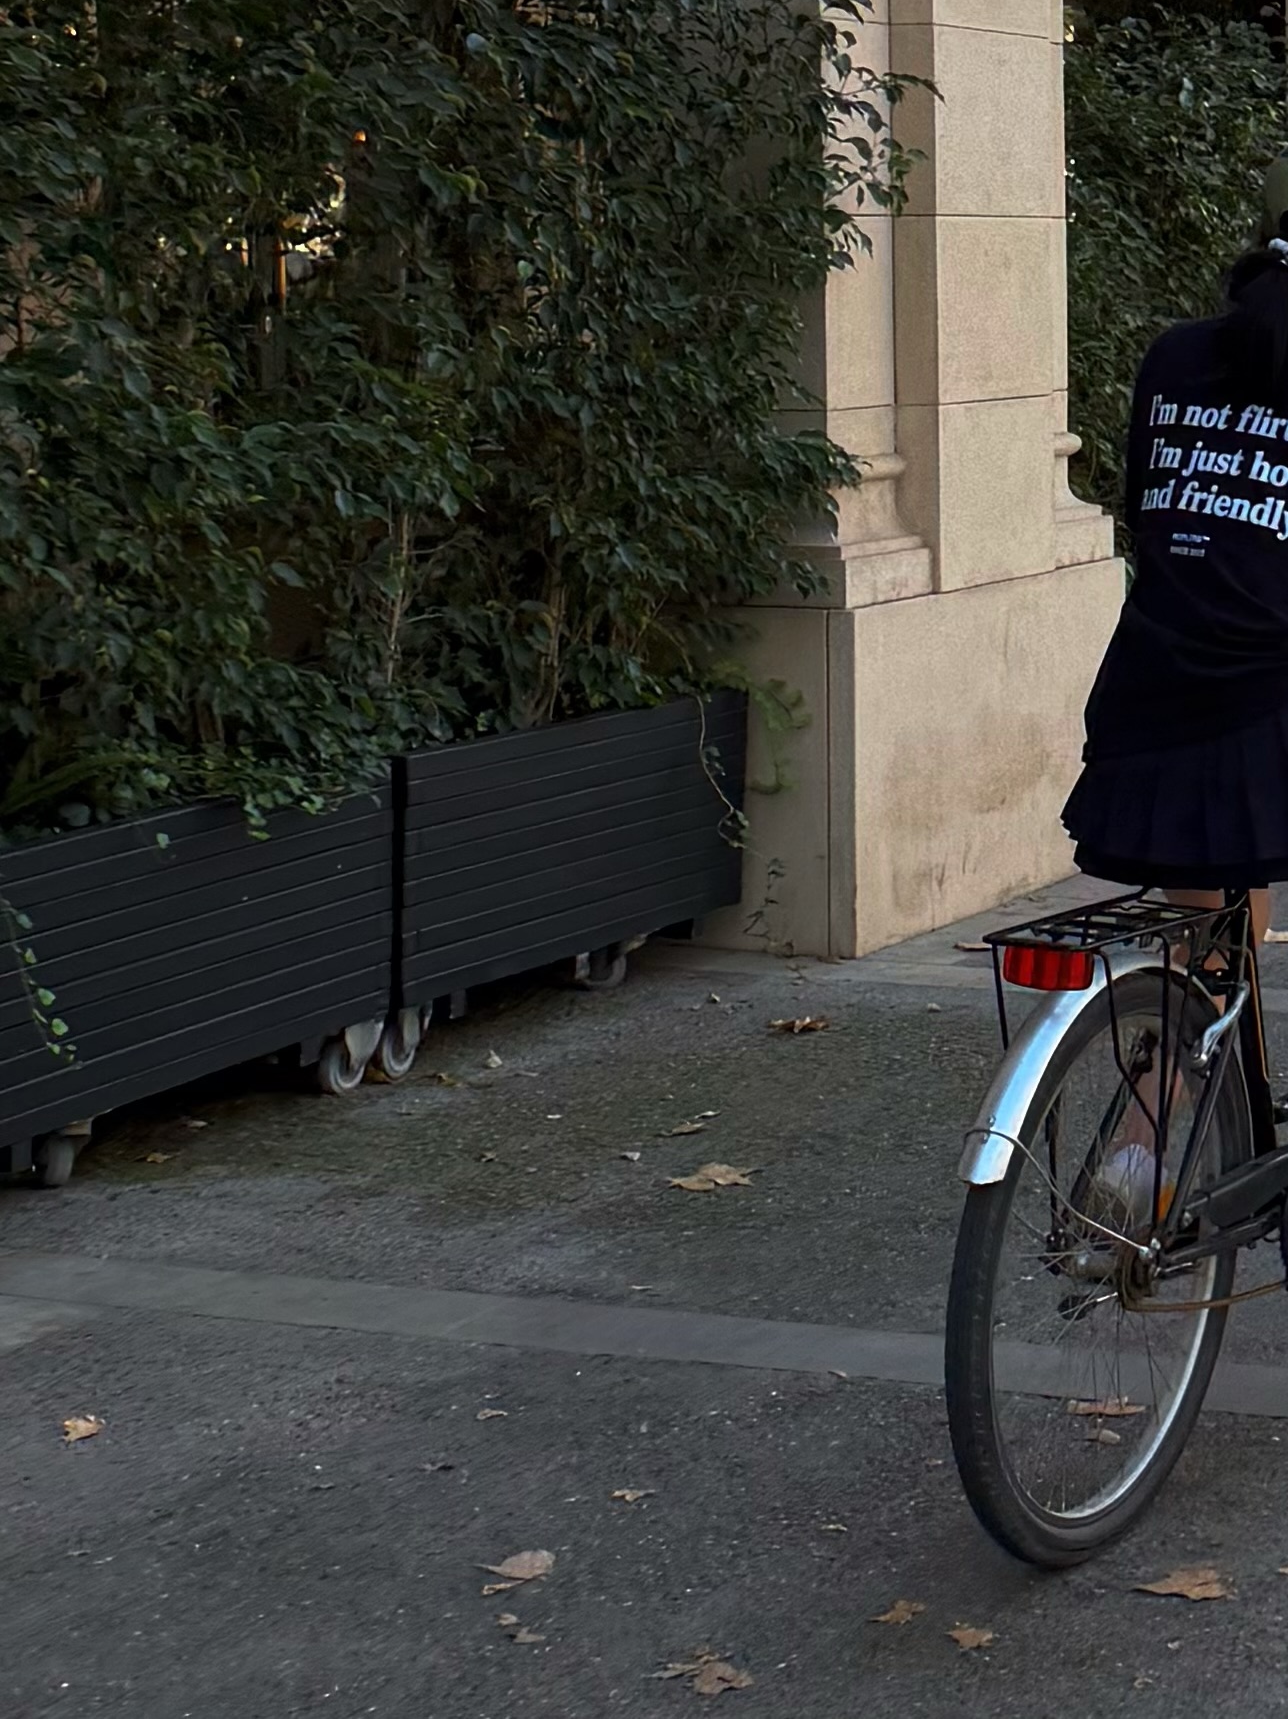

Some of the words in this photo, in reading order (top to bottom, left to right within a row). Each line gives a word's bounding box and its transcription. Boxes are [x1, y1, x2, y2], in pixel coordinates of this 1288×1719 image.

[1149, 394, 1178, 426] I'm
[1182, 404, 1232, 430] not
[1149, 438, 1182, 469] I'm
[1182, 441, 1244, 477] just
